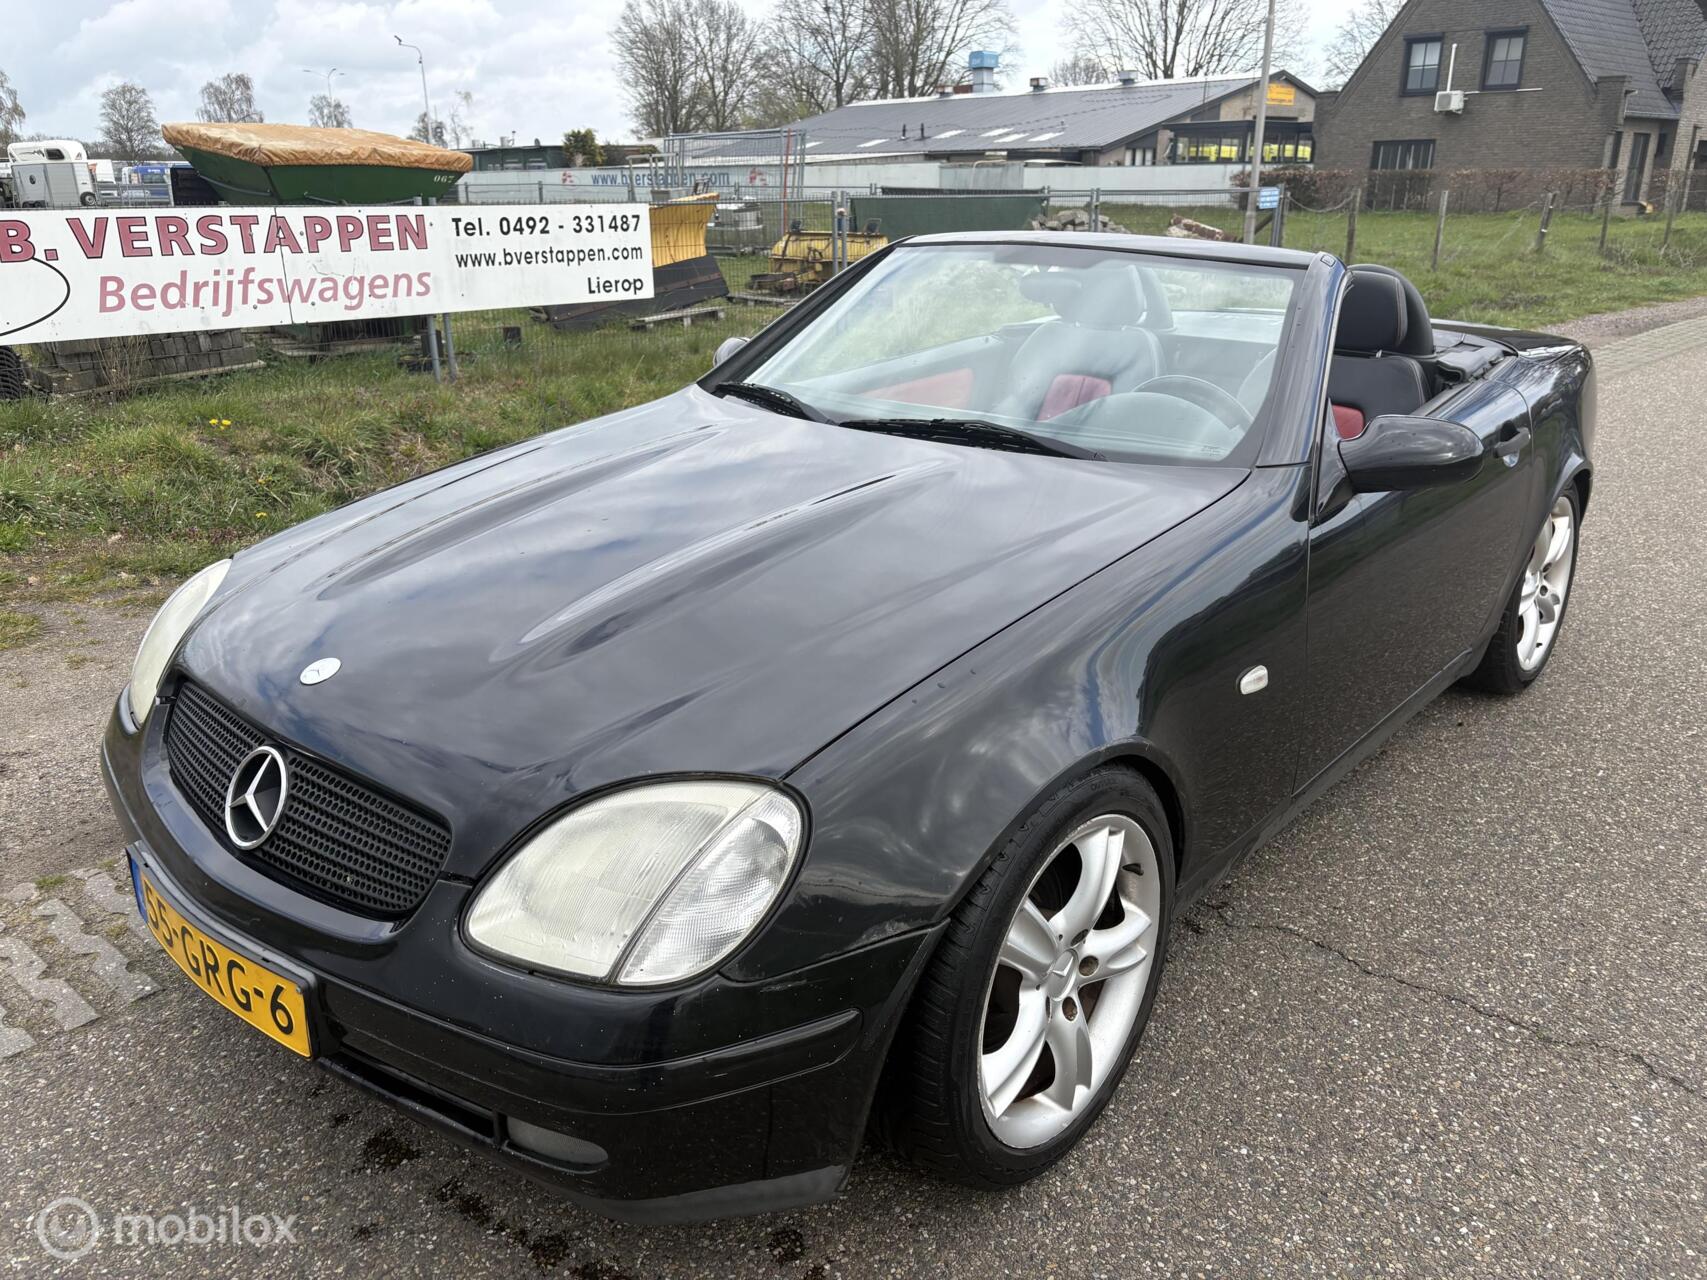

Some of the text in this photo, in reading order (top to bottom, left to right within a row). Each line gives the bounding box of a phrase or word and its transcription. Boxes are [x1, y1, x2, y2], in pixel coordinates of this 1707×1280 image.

[591, 169, 731, 187] www.berstappencom
[452, 217, 490, 237] Tel.
[499, 216, 550, 236] 0492
[572, 214, 641, 234] 331487
[0, 214, 428, 263] B. VERSTAPPEN
[455, 246, 643, 269] www.bverstappen.com
[98, 266, 431, 317] Bedrijfswagens
[587, 276, 644, 295] Lierop
[143, 878, 294, 1036] 55-GRG-6
